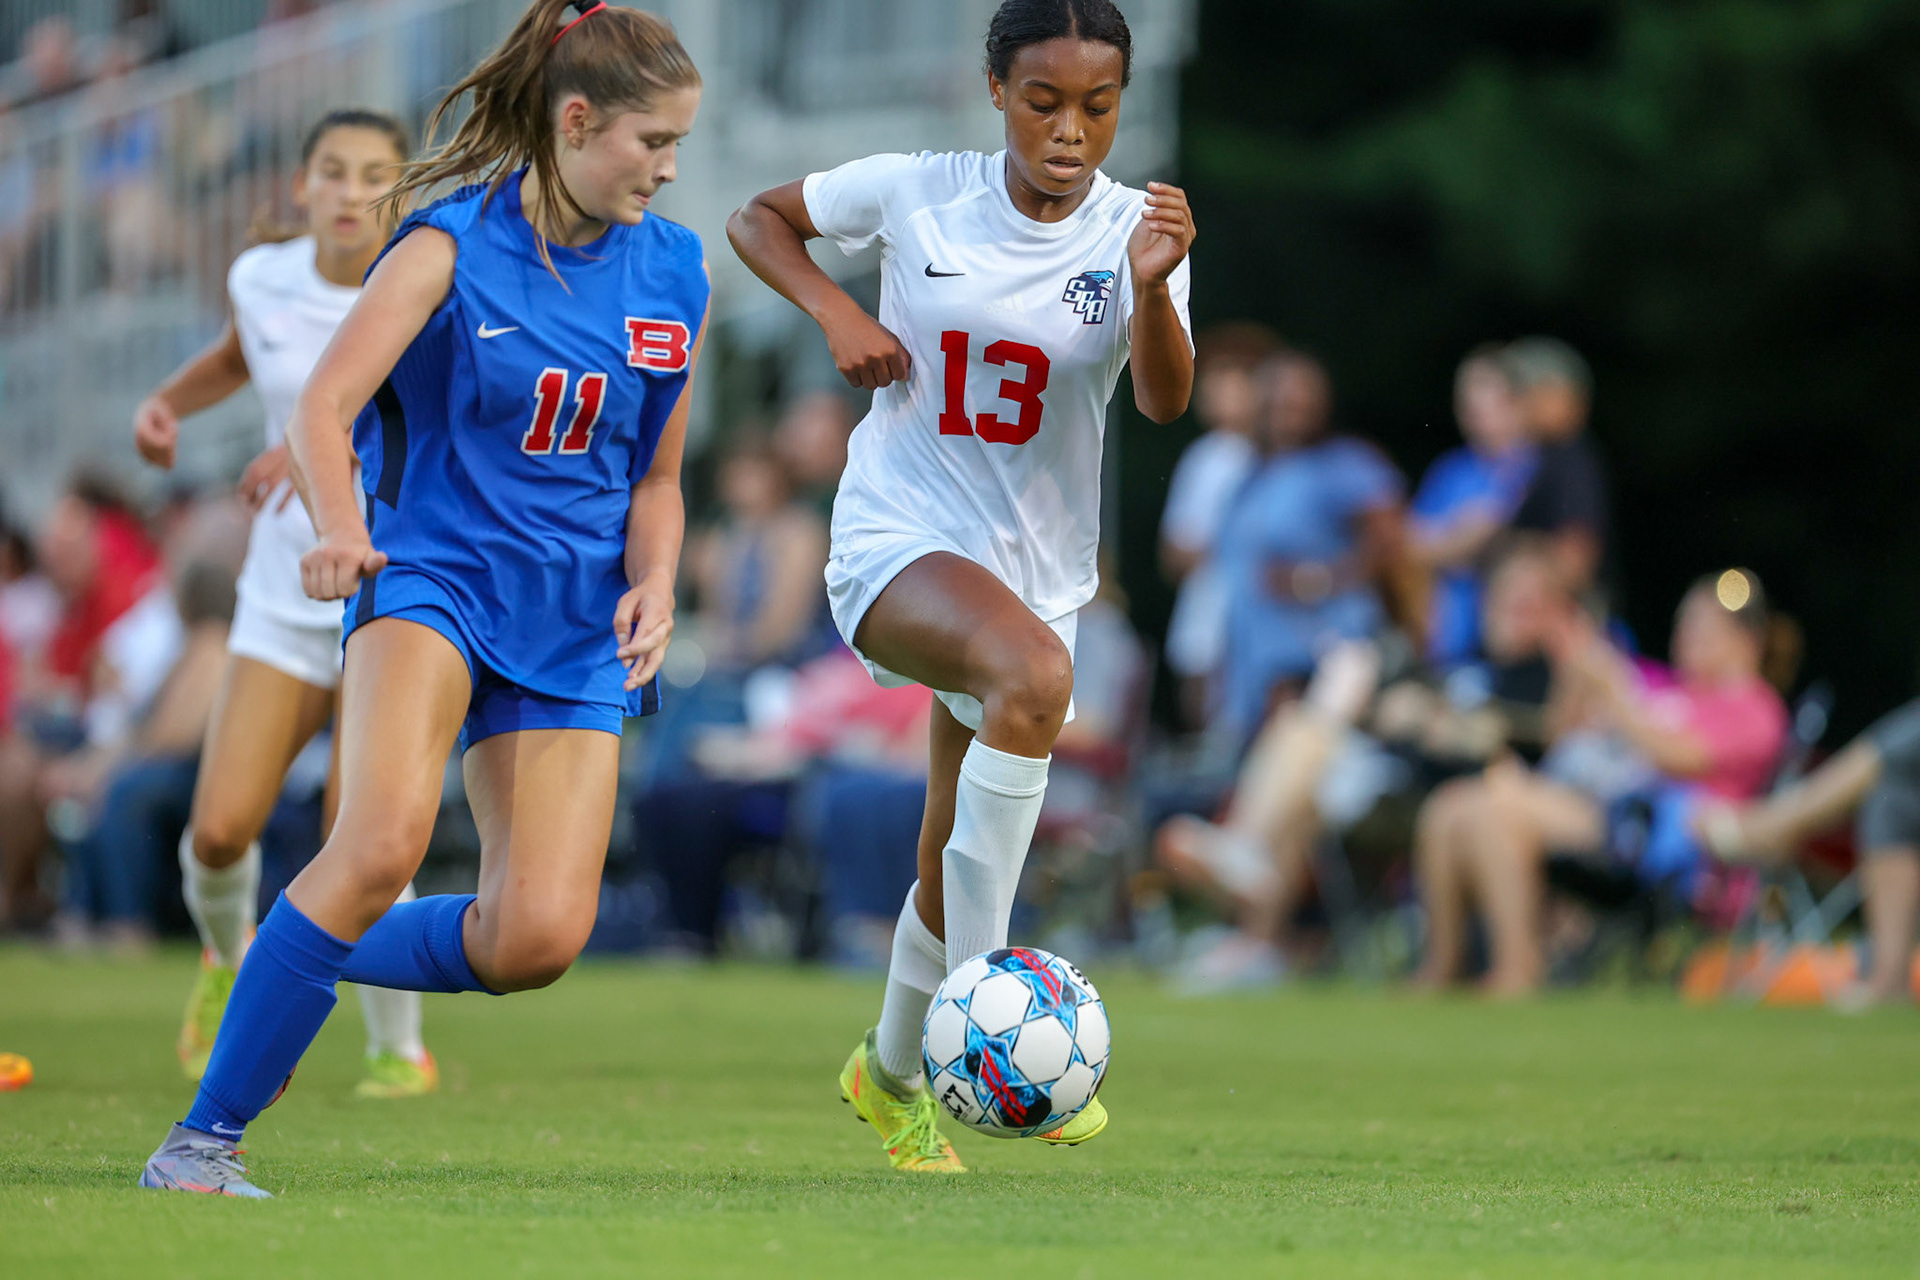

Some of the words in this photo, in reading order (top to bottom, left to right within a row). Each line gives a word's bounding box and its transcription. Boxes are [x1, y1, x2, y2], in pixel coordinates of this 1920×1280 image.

[625, 316, 690, 373] B
[939, 330, 1051, 446] 13
[520, 367, 608, 455] 11
